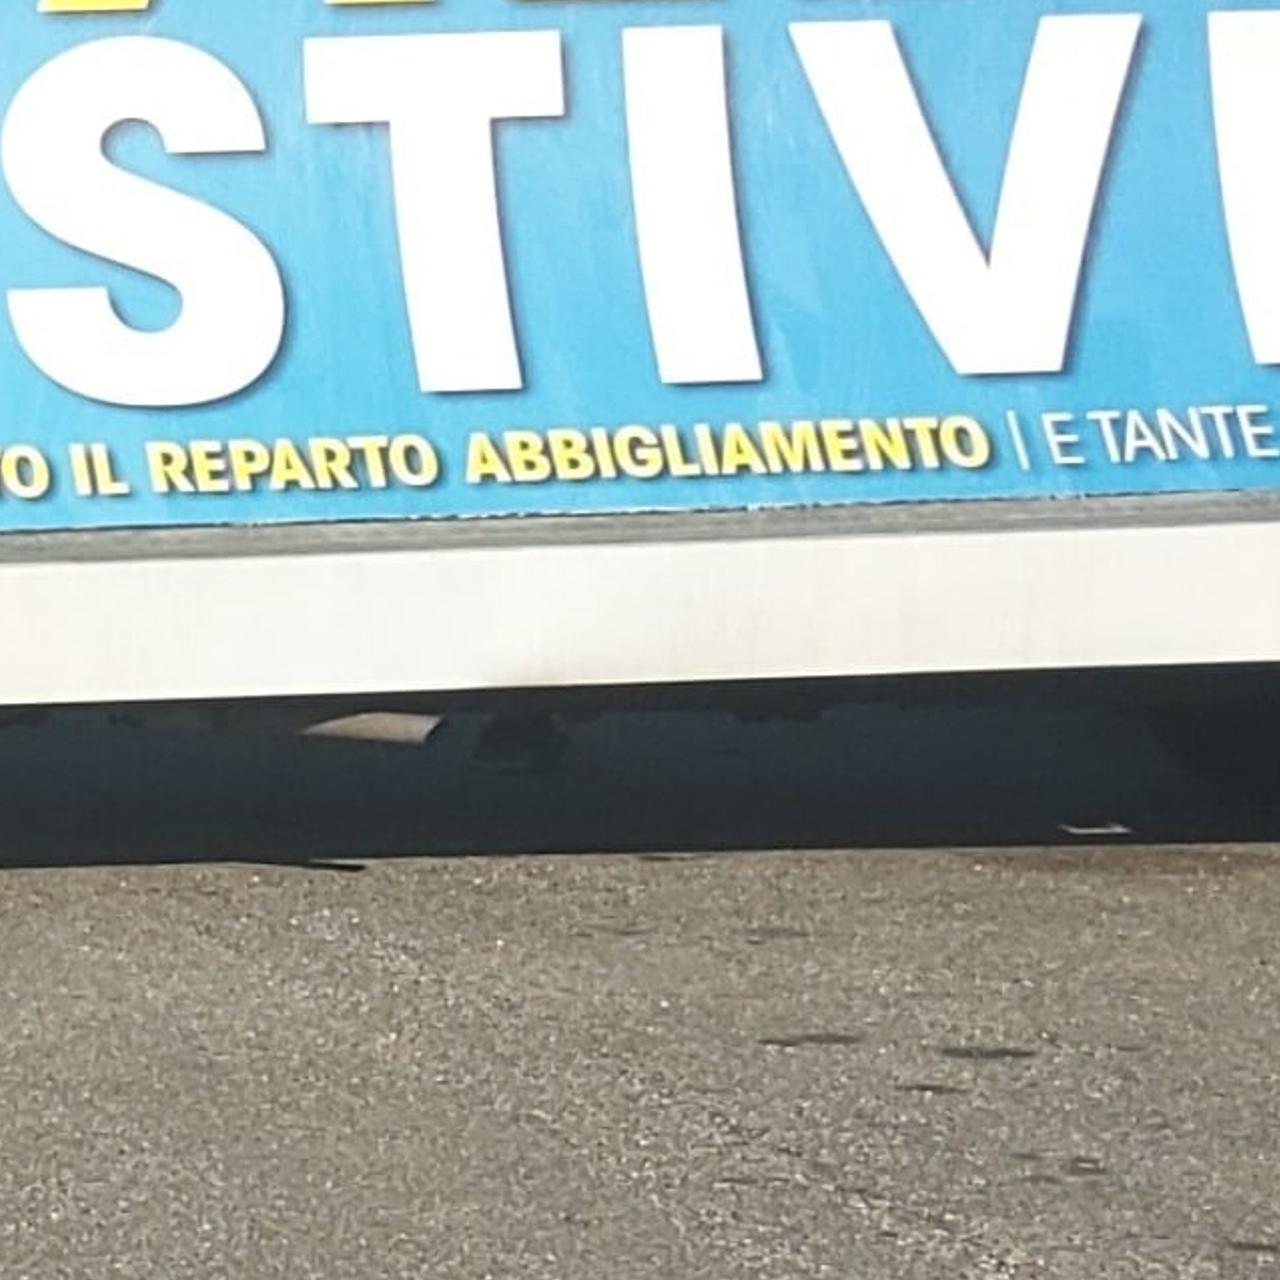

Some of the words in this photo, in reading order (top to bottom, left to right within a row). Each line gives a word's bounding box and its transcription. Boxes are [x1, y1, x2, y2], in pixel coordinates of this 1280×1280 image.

[70, 442, 130, 495] IL
[146, 434, 441, 494] REPARTO
[465, 415, 990, 484] ABBIGLIAMENTO
[1043, 412, 1081, 465] E
[1084, 405, 1280, 462] TANTE
